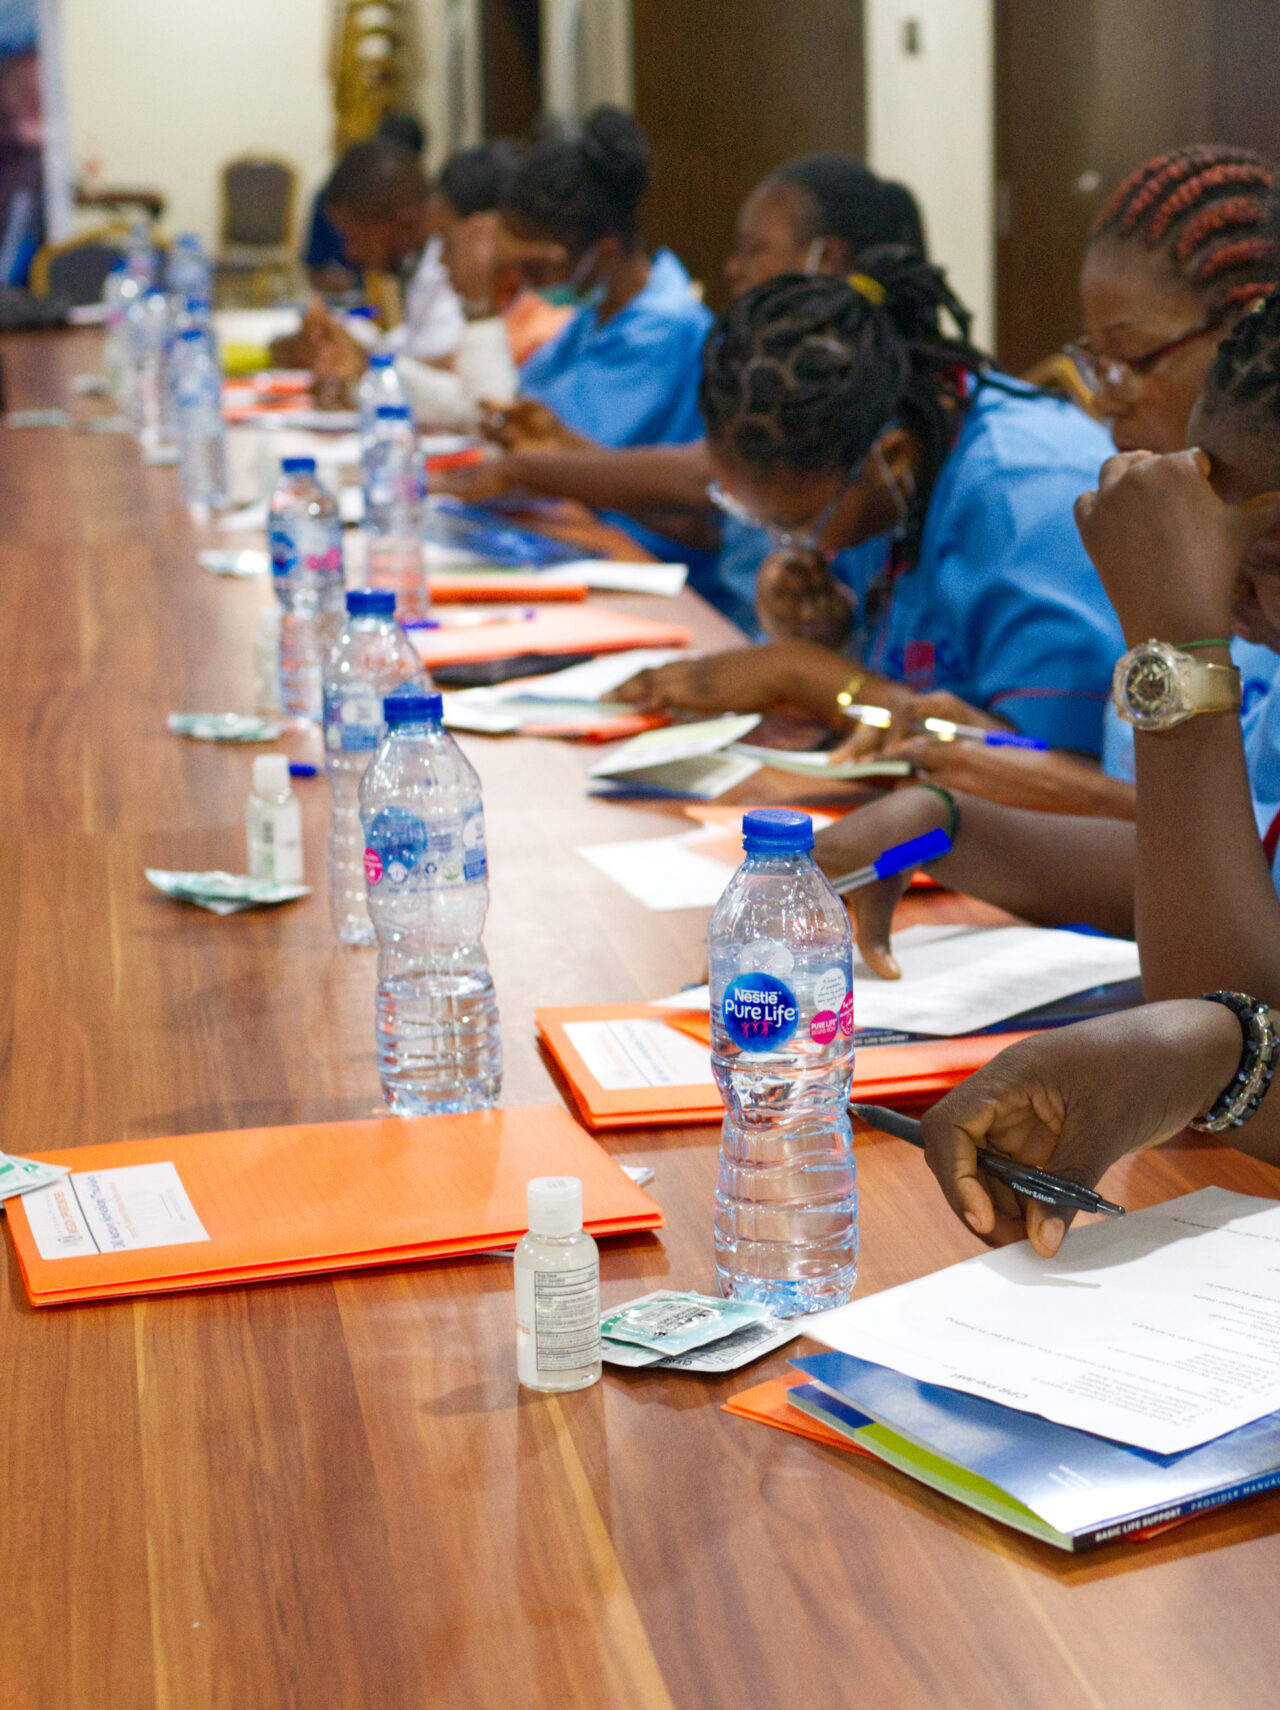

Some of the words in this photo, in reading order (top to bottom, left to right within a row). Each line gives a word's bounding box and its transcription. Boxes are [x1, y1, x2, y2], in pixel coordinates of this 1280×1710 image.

[725, 1000, 762, 1020] Pure
[766, 1005, 796, 1028] Life
[1094, 1527, 1122, 1542] BASIC
[1123, 1521, 1141, 1534] LIFE
[1142, 1507, 1182, 1528] SUPPORT
[1190, 1489, 1239, 1511] PROVIDER
